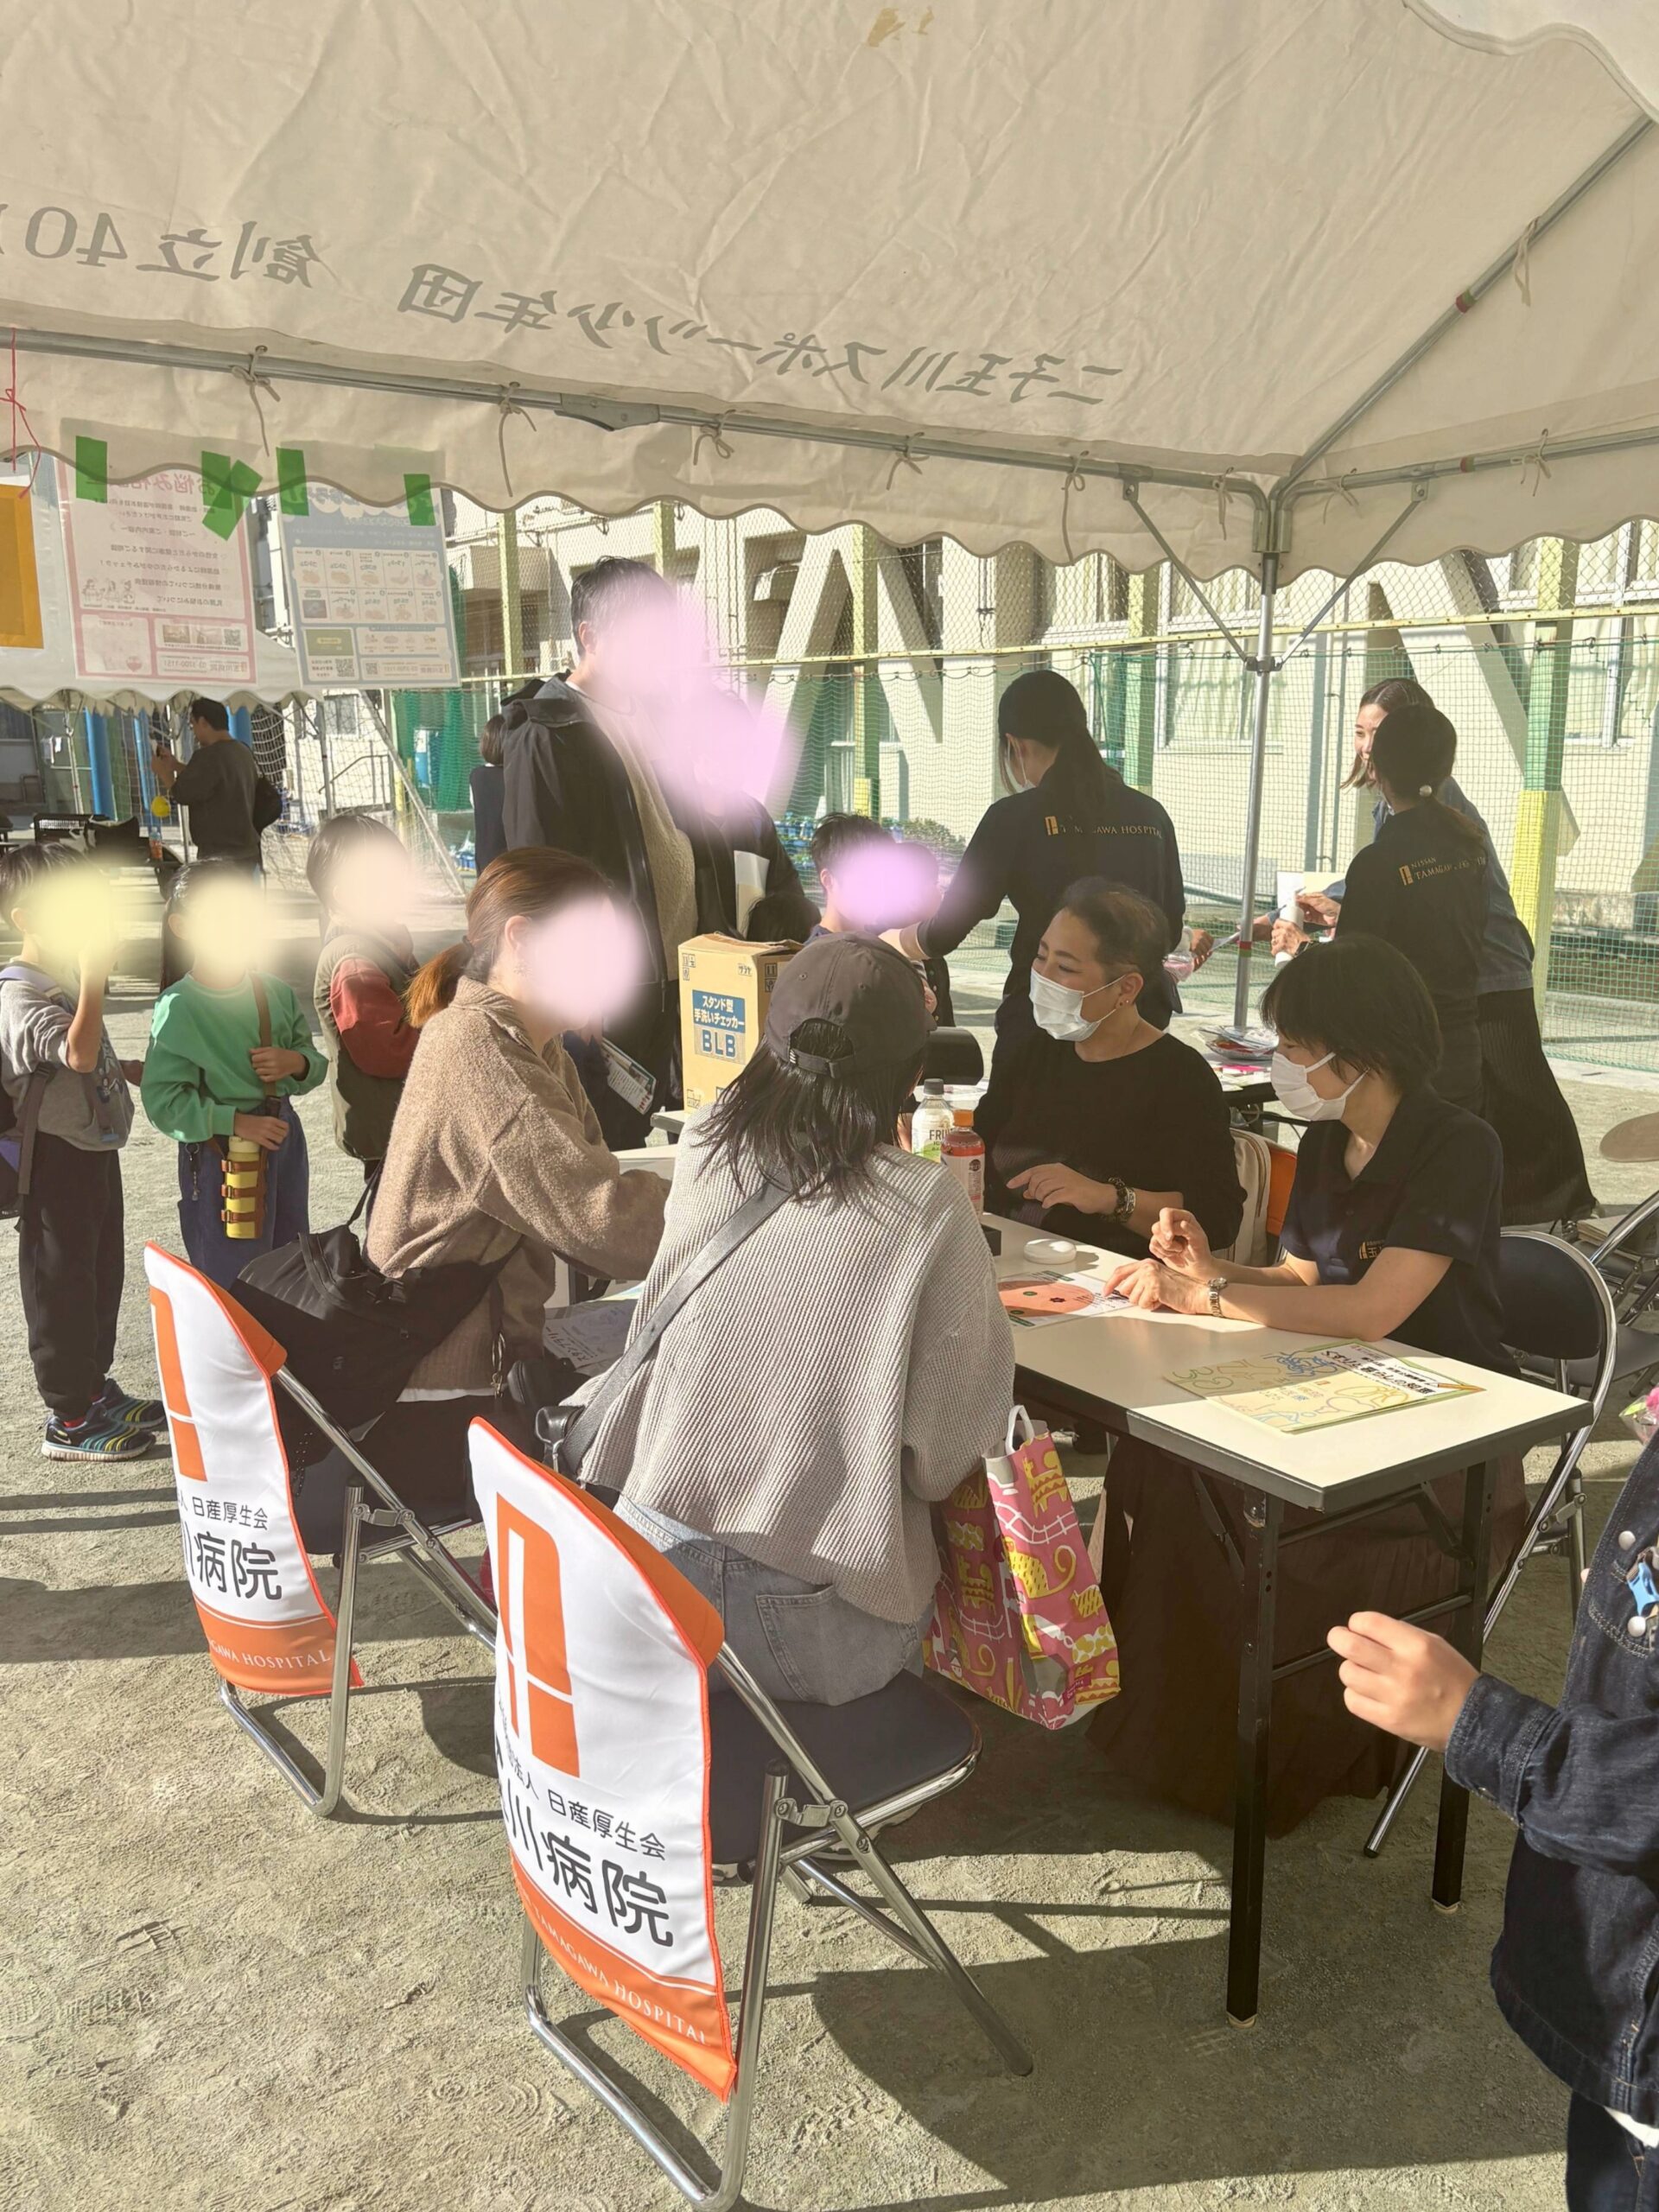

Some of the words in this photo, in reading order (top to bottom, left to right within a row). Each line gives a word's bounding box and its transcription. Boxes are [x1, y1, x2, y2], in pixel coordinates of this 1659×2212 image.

[694, 1009, 745, 1030] 手洗いチェッカー
[702, 995, 734, 1013] スタンド型
[702, 1029, 736, 1058] BLB
[192, 1496, 269, 1531] 日産厚生会
[241, 1649, 332, 1669] HOSPITAL
[547, 1788, 666, 1861] 日産厚生会
[497, 1735, 674, 1948] 川病院
[613, 1978, 712, 2047] HOSPITAL
